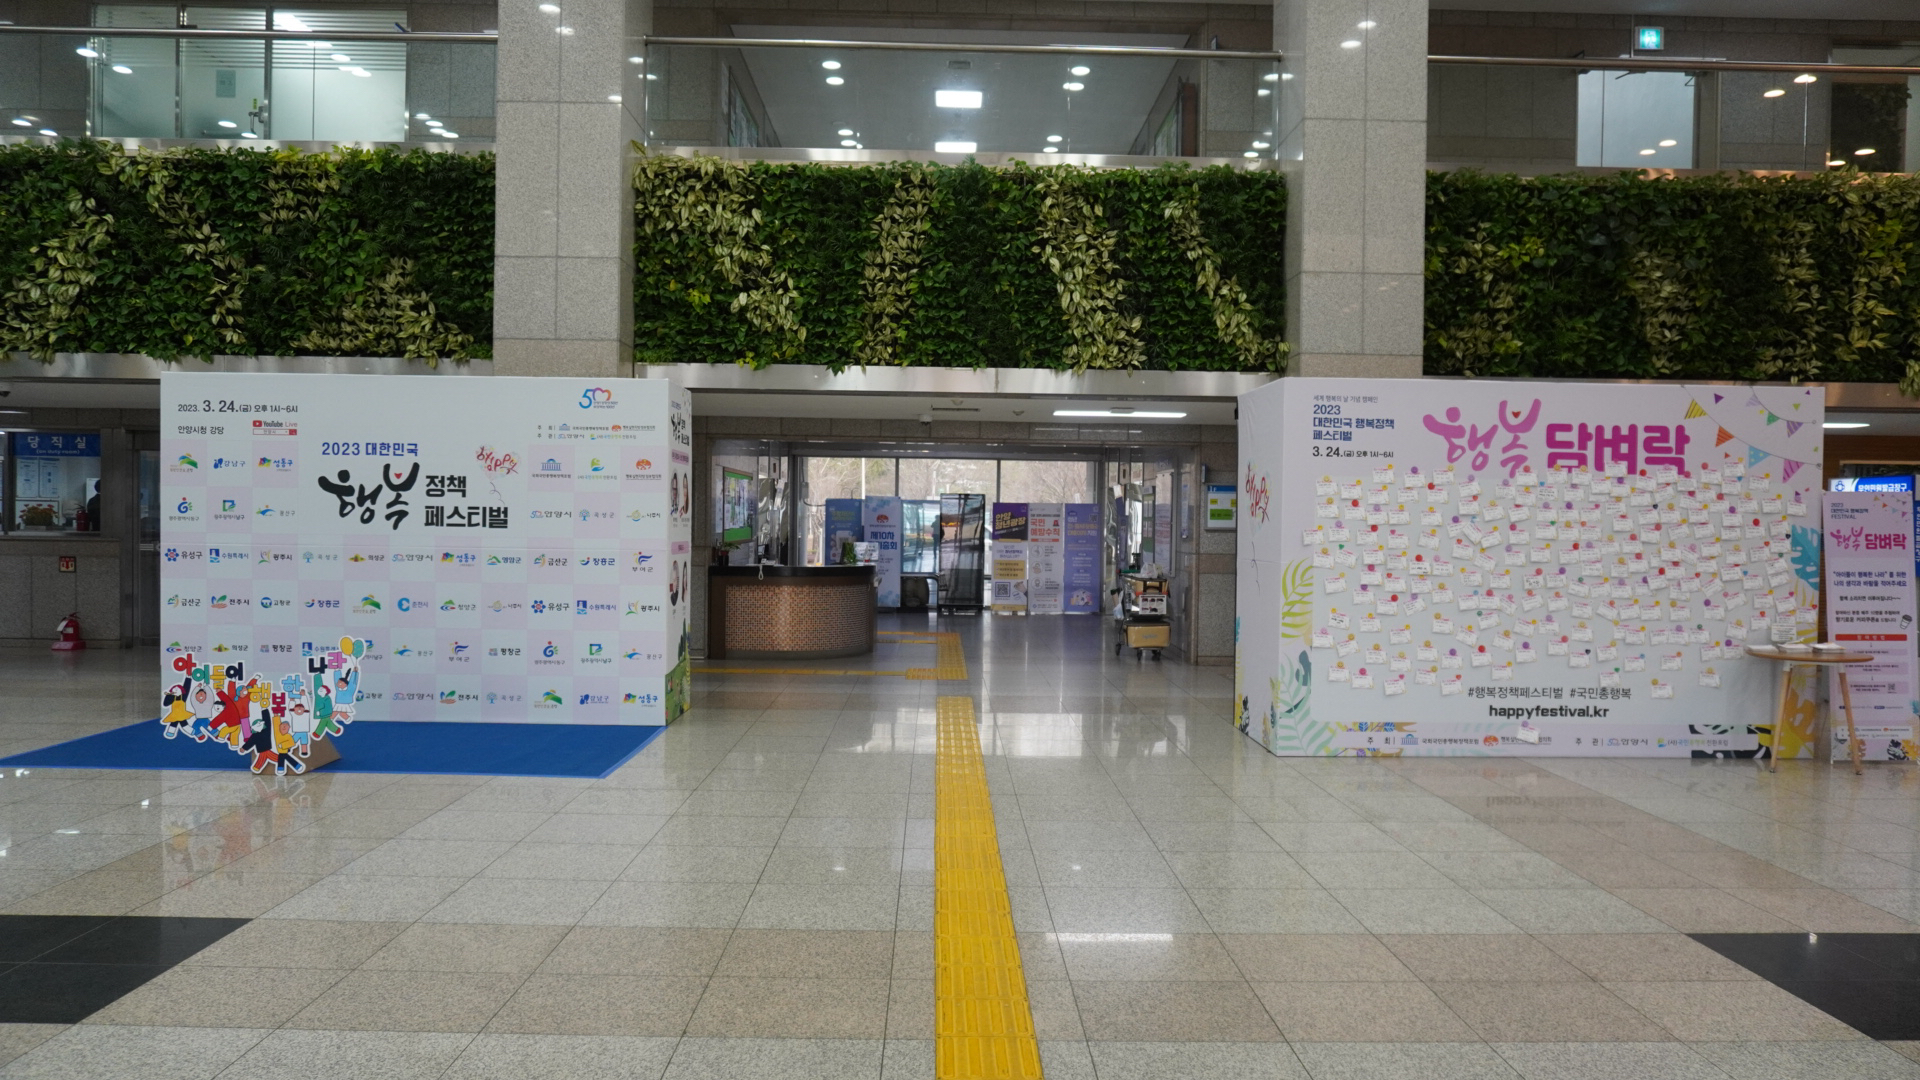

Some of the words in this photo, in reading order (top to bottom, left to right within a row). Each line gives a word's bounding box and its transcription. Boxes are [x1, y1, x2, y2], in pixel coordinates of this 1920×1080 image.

[178, 404, 200, 412] 2023.
[203, 400, 215, 412] 3.
[1313, 404, 1341, 415] 2023
[1313, 417, 1352, 428] 대한민국
[1356, 418, 1394, 429] 행복정책
[178, 426, 207, 434] 안양시청
[210, 426, 224, 434] 강당
[1313, 430, 1352, 441] 페스티벌
[28, 436, 86, 448] 당직실
[1423, 399, 1542, 478] 행복
[1546, 423, 1690, 475] 담벼락
[322, 442, 360, 456] 2023
[365, 443, 418, 456] 대한민국
[1313, 446, 1323, 457] 3.
[273, 458, 293, 468] 성동구
[318, 462, 420, 530] 행복
[425, 475, 466, 498] 정책
[424, 506, 508, 528] 페스티벌
[1830, 526, 1863, 551] 행복
[1865, 533, 1906, 550] 담벼락
[181, 551, 202, 559] 유성구
[456, 553, 476, 563] 성동구
[317, 600, 340, 608] 장흥군
[548, 603, 570, 611] 유성구
[173, 654, 243, 689] 아이들이
[248, 674, 304, 717] 행복한
[308, 652, 347, 674] 나라
[638, 694, 658, 703] 성동구
[1468, 687, 1563, 699] #행복정책페스티벌
[1570, 688, 1632, 699] #국민총행복
[1489, 705, 1609, 719] happyfestival.kr
